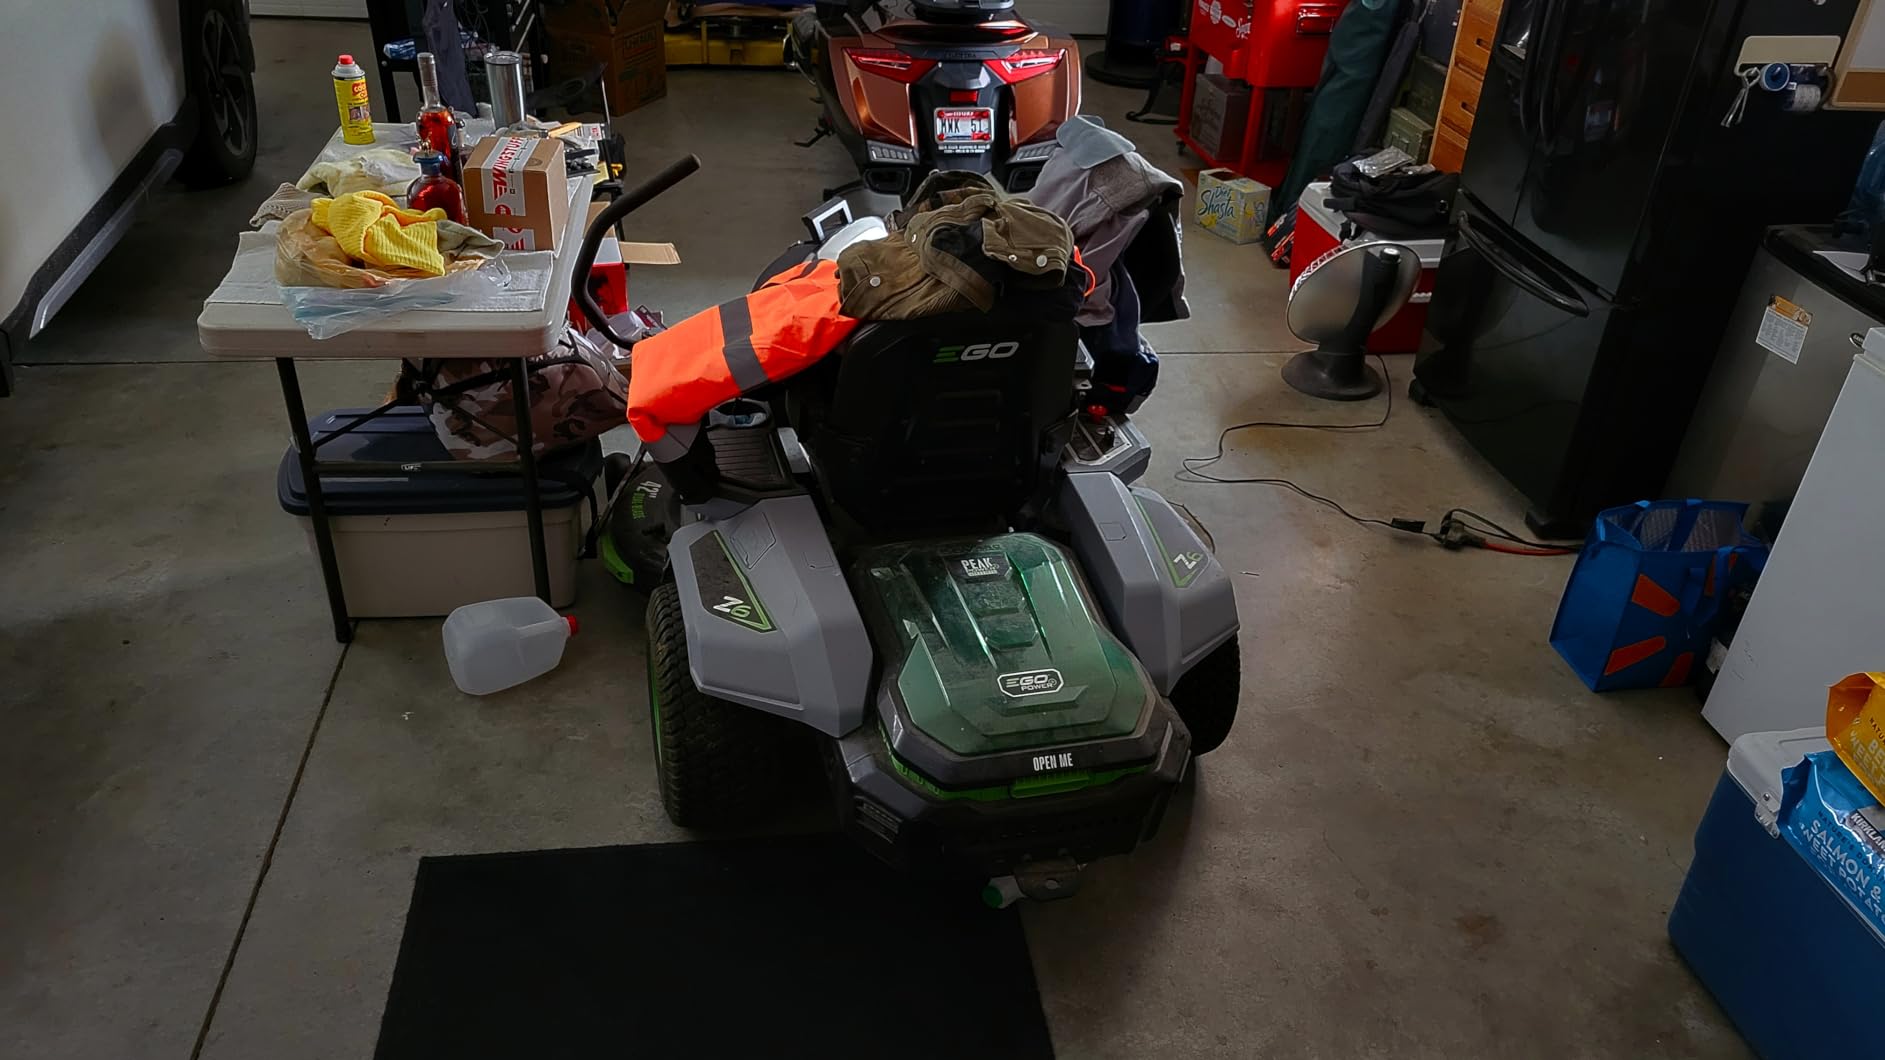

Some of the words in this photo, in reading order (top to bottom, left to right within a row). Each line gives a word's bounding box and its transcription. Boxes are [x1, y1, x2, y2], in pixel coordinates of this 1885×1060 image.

[1214, 185, 1232, 198] Diet
[1198, 189, 1237, 220] Shasta
[933, 341, 1019, 363] EGO
[961, 557, 993, 575] PEAK
[1173, 551, 1204, 570] Z6
[713, 595, 751, 618] Z6
[1006, 674, 1050, 688] EGO
[1032, 754, 1058, 771] OPEN
[1058, 752, 1074, 768] ME
[1850, 812, 1885, 852] KIRKLAN
[1811, 819, 1870, 889] SALMON
[1870, 885, 1882, 903] &
